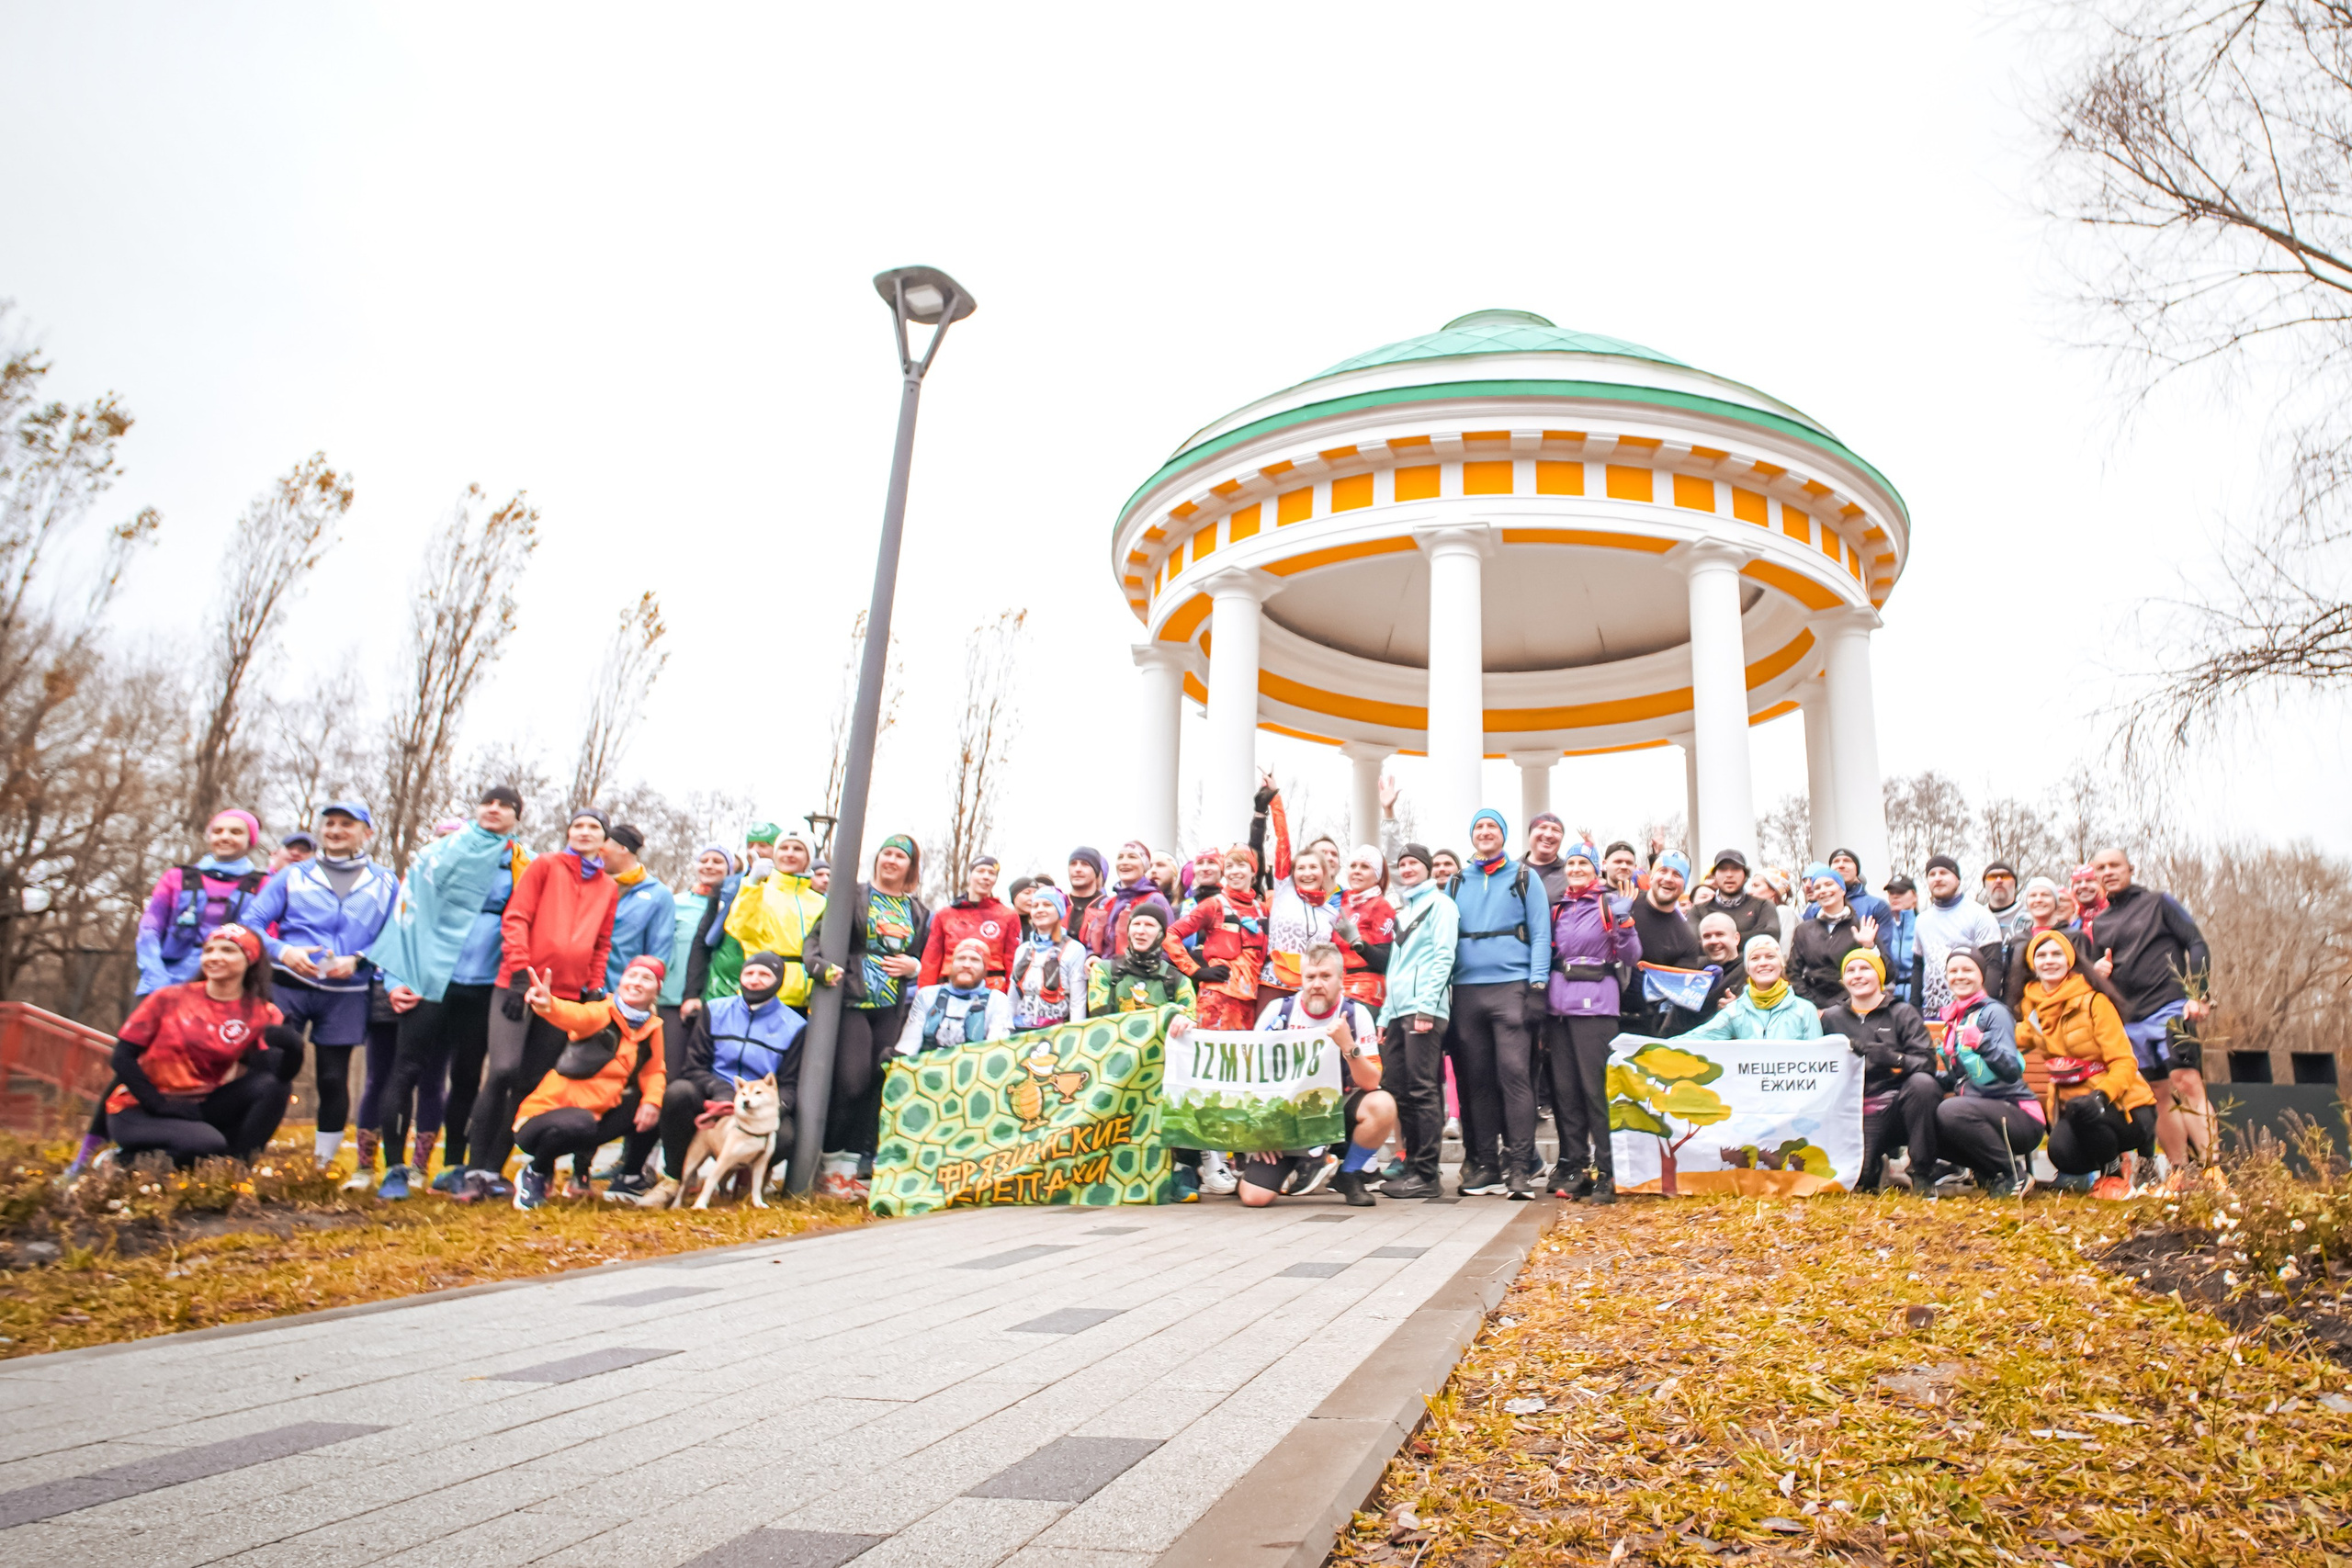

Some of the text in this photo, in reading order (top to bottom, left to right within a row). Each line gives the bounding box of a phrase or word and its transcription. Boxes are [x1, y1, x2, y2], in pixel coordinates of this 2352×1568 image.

[1737, 1060, 1839, 1077] МЕЩЕРСКИЕ
[1761, 1077, 1816, 1092] ЁЖИКИ
[936, 1115, 1133, 1194] ФРЯЗИНСКИЕ
